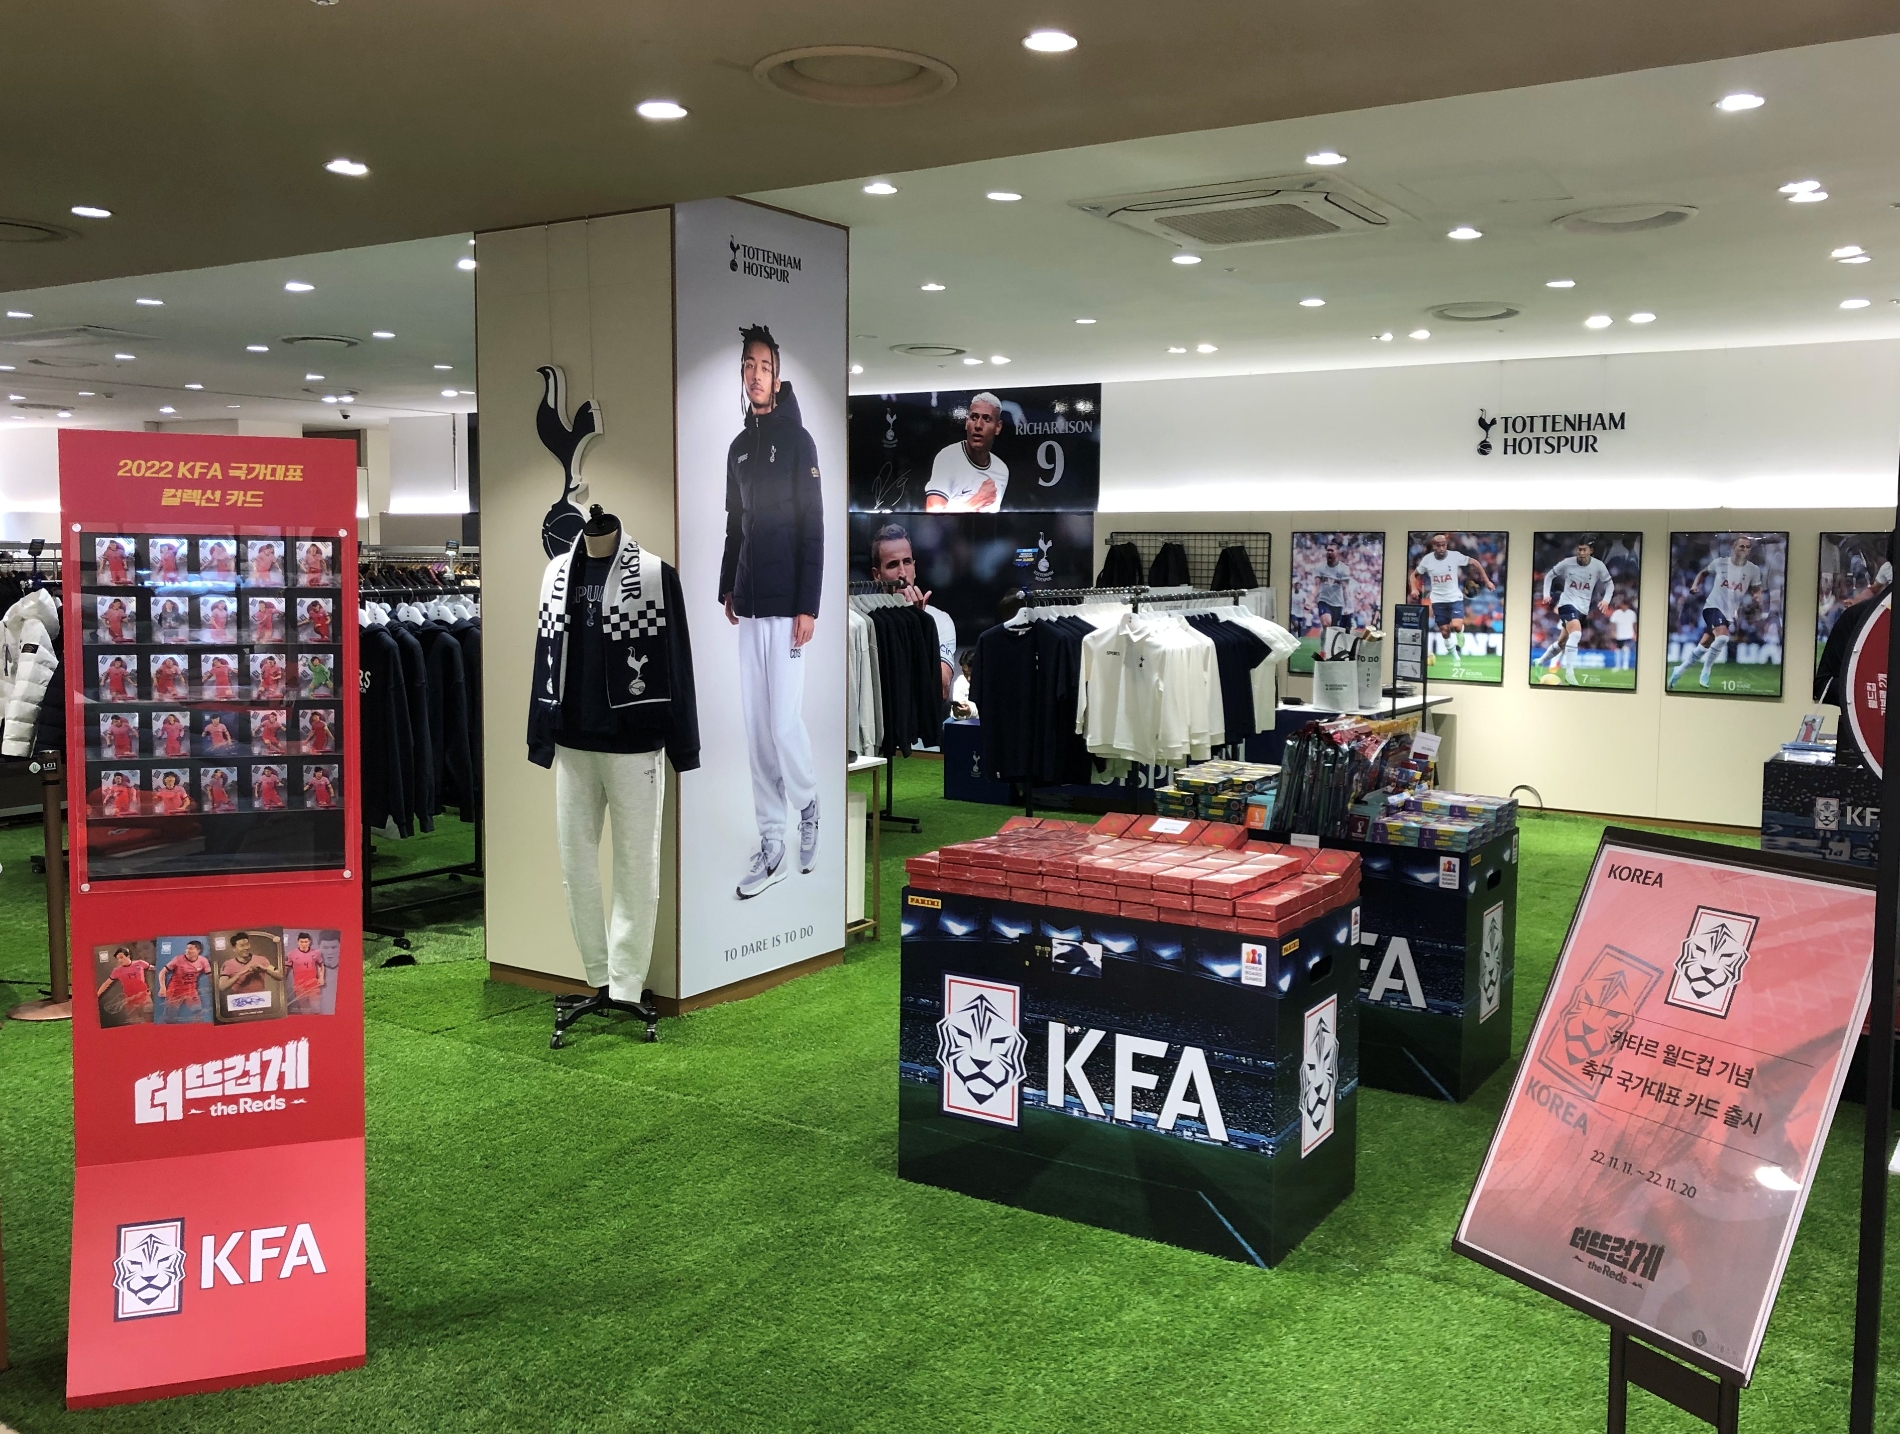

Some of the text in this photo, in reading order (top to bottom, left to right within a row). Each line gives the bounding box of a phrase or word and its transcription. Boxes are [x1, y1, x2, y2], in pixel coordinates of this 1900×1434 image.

[741, 244, 802, 271] TOTTENHAM
[743, 260, 790, 283] HOTSPUR
[1501, 412, 1626, 434] TOTTENHAM
[1503, 435, 1599, 455] HOTSPUR
[117, 459, 304, 482] 2022 KFA 국가대표
[1036, 440, 1065, 487] 9
[161, 488, 264, 508] 컬렉션 카드
[1451, 668, 1466, 678] 27
[1581, 674, 1589, 684] 7
[1721, 680, 1736, 691] 10
[1846, 805, 1880, 827] KF
[1608, 864, 1663, 888] KOREA
[909, 897, 940, 907] PANINI
[724, 925, 814, 962] TO DARE IS TO DO
[1610, 1030, 1754, 1089] 카타르 월드컵 기념
[134, 1037, 309, 1124] 더뜨겁게
[1047, 1020, 1230, 1142] KFA
[1524, 1075, 1589, 1136] KOREA
[1581, 1060, 1763, 1135] 축구 국가대표 카드 출시
[200, 1222, 327, 1290] KFA
[1569, 1226, 1666, 1283] 더뜨겁게
